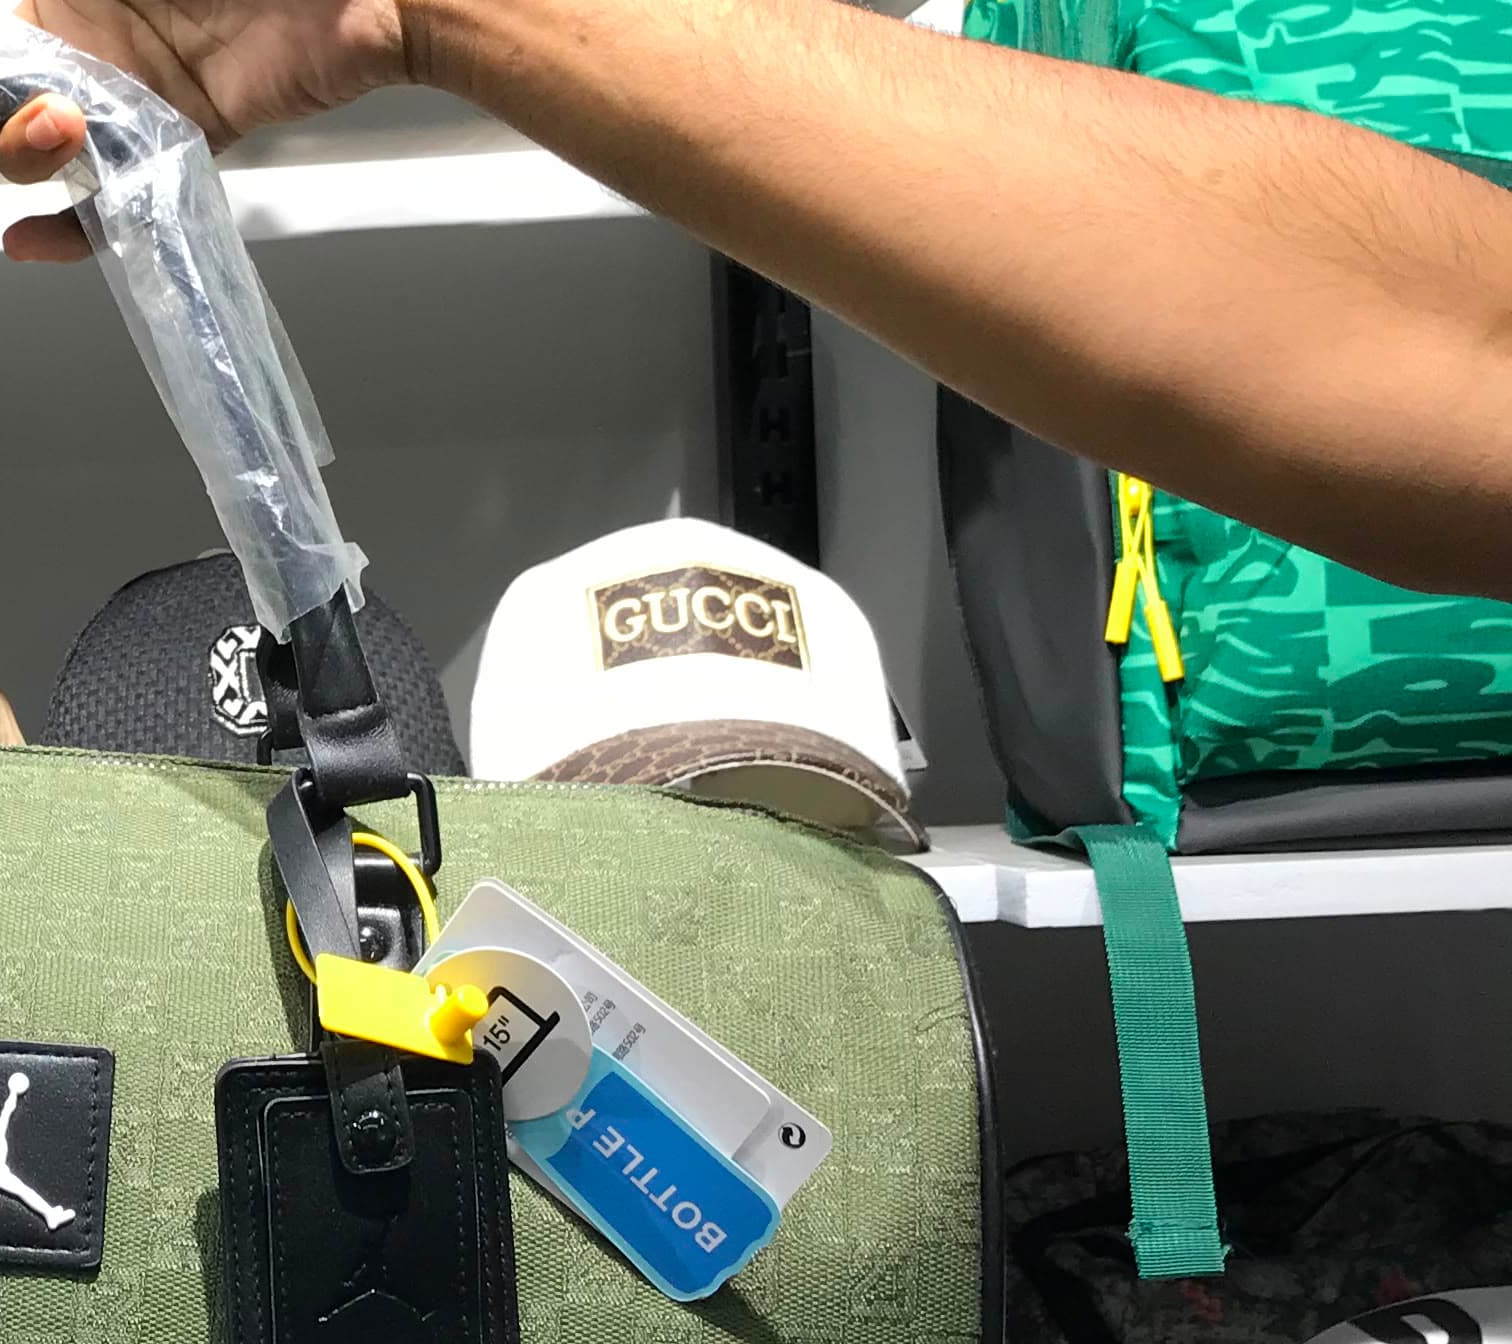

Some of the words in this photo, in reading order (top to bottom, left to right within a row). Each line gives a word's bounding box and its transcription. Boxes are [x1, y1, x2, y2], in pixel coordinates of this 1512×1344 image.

[604, 586, 797, 643] GUCCI
[483, 1015, 510, 1051] 15"
[592, 1126, 727, 1253] BOTTLE
